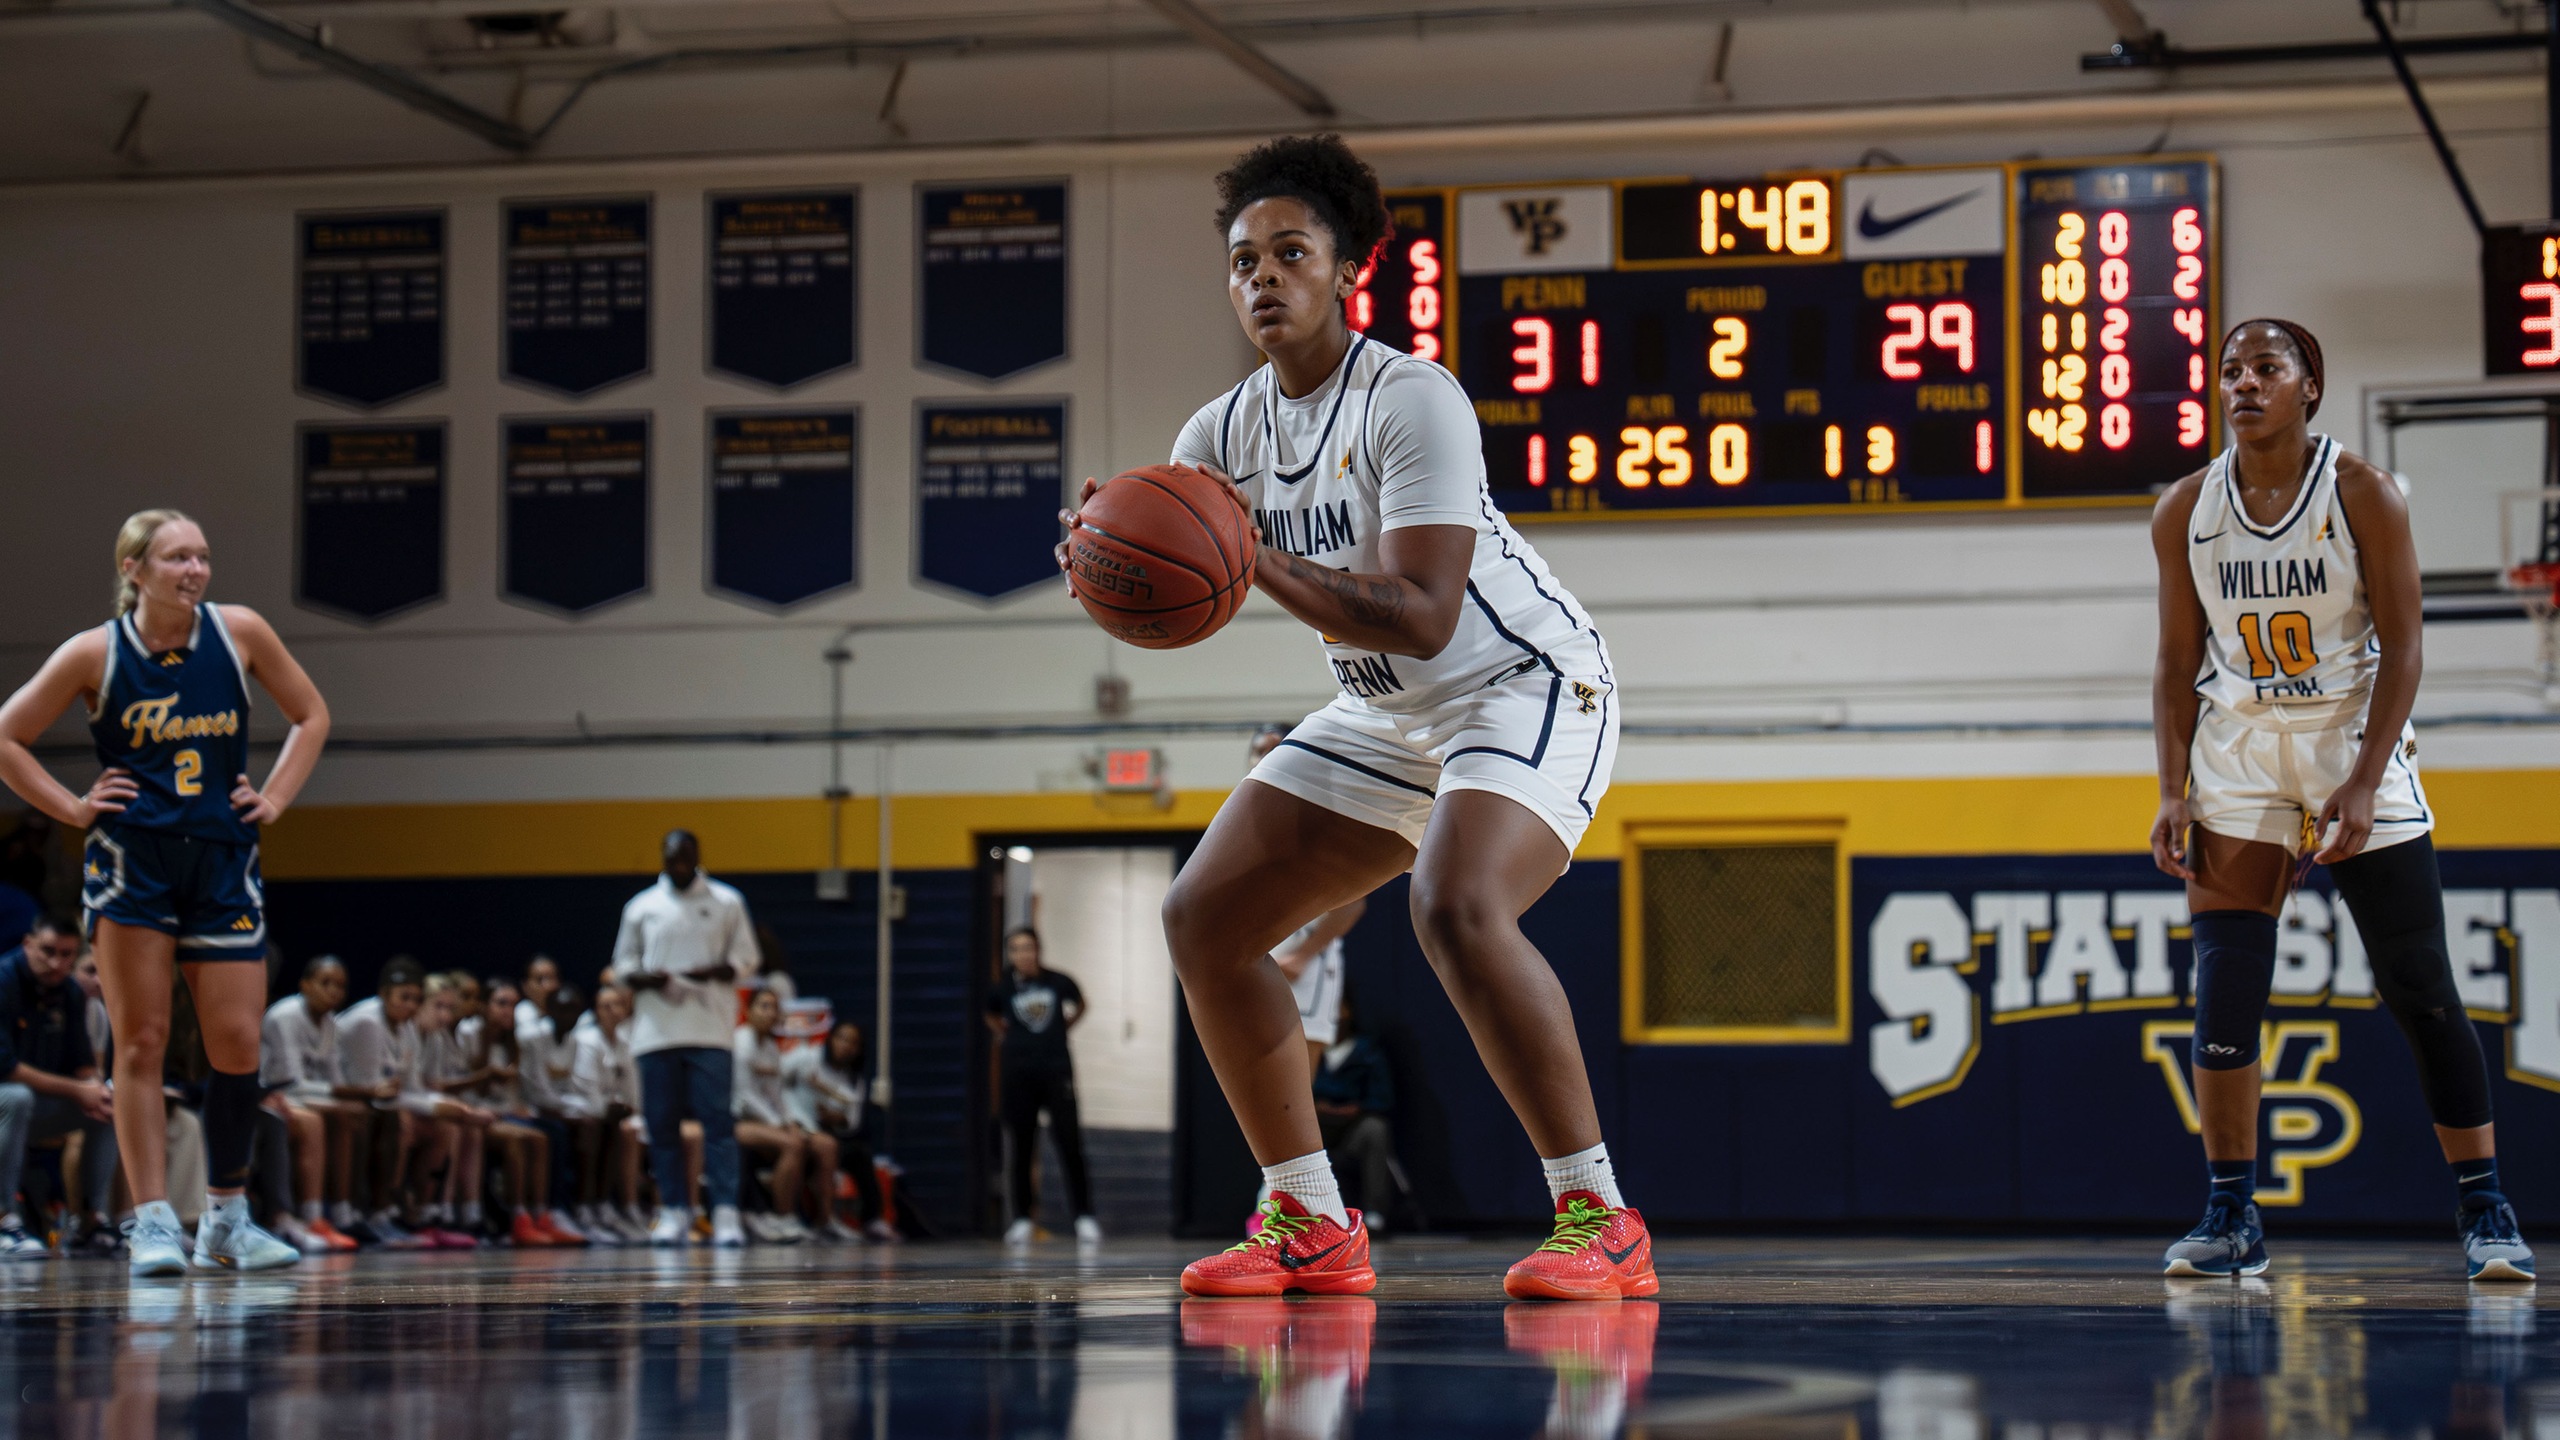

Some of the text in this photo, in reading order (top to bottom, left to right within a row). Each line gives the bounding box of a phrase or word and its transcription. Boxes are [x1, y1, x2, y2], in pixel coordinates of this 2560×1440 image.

[1700, 180, 1830, 255] 1:48
[2055, 208, 2202, 258] 2 0 6
[1502, 275, 1586, 312] PENN
[1687, 285, 1768, 311] PERIOD
[1862, 260, 1968, 297] GUEST
[2041, 255, 2202, 306] 10 0 2
[1409, 285, 1440, 330] 0
[2042, 307, 2203, 352] 11 2 4
[2519, 282, 2560, 367] 3
[1511, 317, 1600, 392] 31
[1708, 317, 1749, 379] 2
[1882, 302, 1975, 379] 29
[2042, 353, 2204, 401] 12 0 1
[1867, 426, 1895, 475] 3
[1976, 420, 1993, 474] 1
[2027, 400, 2205, 452] 42 0 3
[1528, 434, 1546, 487] 1
[1568, 435, 1597, 483] 3
[1616, 423, 1842, 489] 25 0 1
[1255, 499, 1356, 557] WILLIAM
[2218, 557, 2328, 600] WILLIAM
[2237, 610, 2319, 679] 10
[1332, 653, 1405, 698] PENN
[1571, 679, 1599, 717] WP
[121, 692, 239, 749] Flames
[174, 749, 204, 797] 2
[1868, 889, 2560, 1106] STATSE
